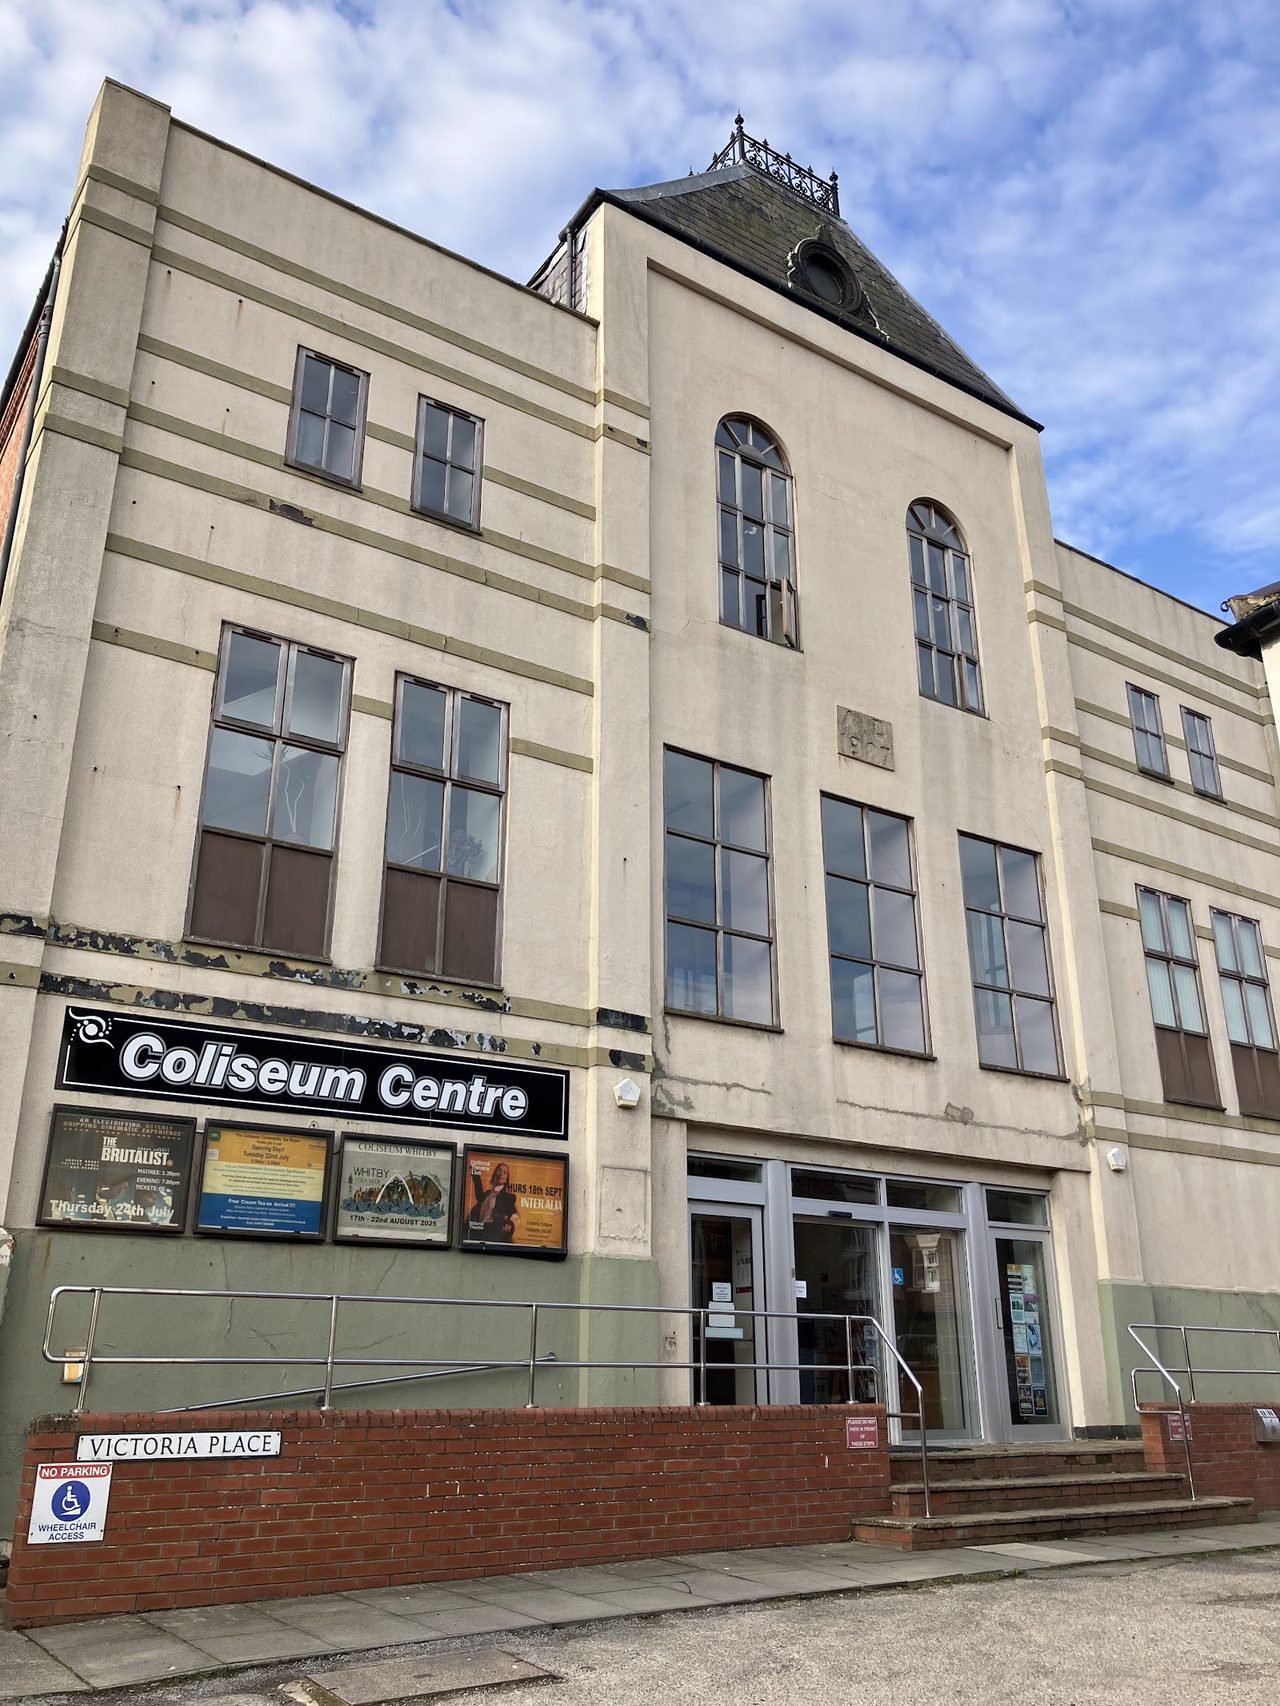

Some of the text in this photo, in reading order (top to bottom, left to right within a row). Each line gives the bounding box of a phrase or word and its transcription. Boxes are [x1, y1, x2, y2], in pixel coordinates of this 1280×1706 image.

[120, 1032, 528, 1119] Coliseum Centre
[103, 1136, 118, 1147] THE
[243, 1151, 264, 1159] Tuesday
[358, 1143, 438, 1158] COLISEUM WHITBY
[101, 1147, 169, 1166] BRUTALIST
[353, 1167, 390, 1178] WHITBY
[529, 1185, 544, 1196] 18th
[545, 1186, 563, 1197] SEPT
[50, 1200, 174, 1218] Thursday 24th July
[520, 1197, 562, 1211] INTER ALIA
[371, 1216, 388, 1224] 22nd
[390, 1218, 418, 1226] AUGUST
[420, 1219, 437, 1227] 2025
[90, 1435, 272, 1456] VICTORIA PLACE
[41, 1466, 109, 1477] NO PARKING
[38, 1522, 97, 1532] WHEELCHAIR
[48, 1532, 85, 1541] ACCESS
